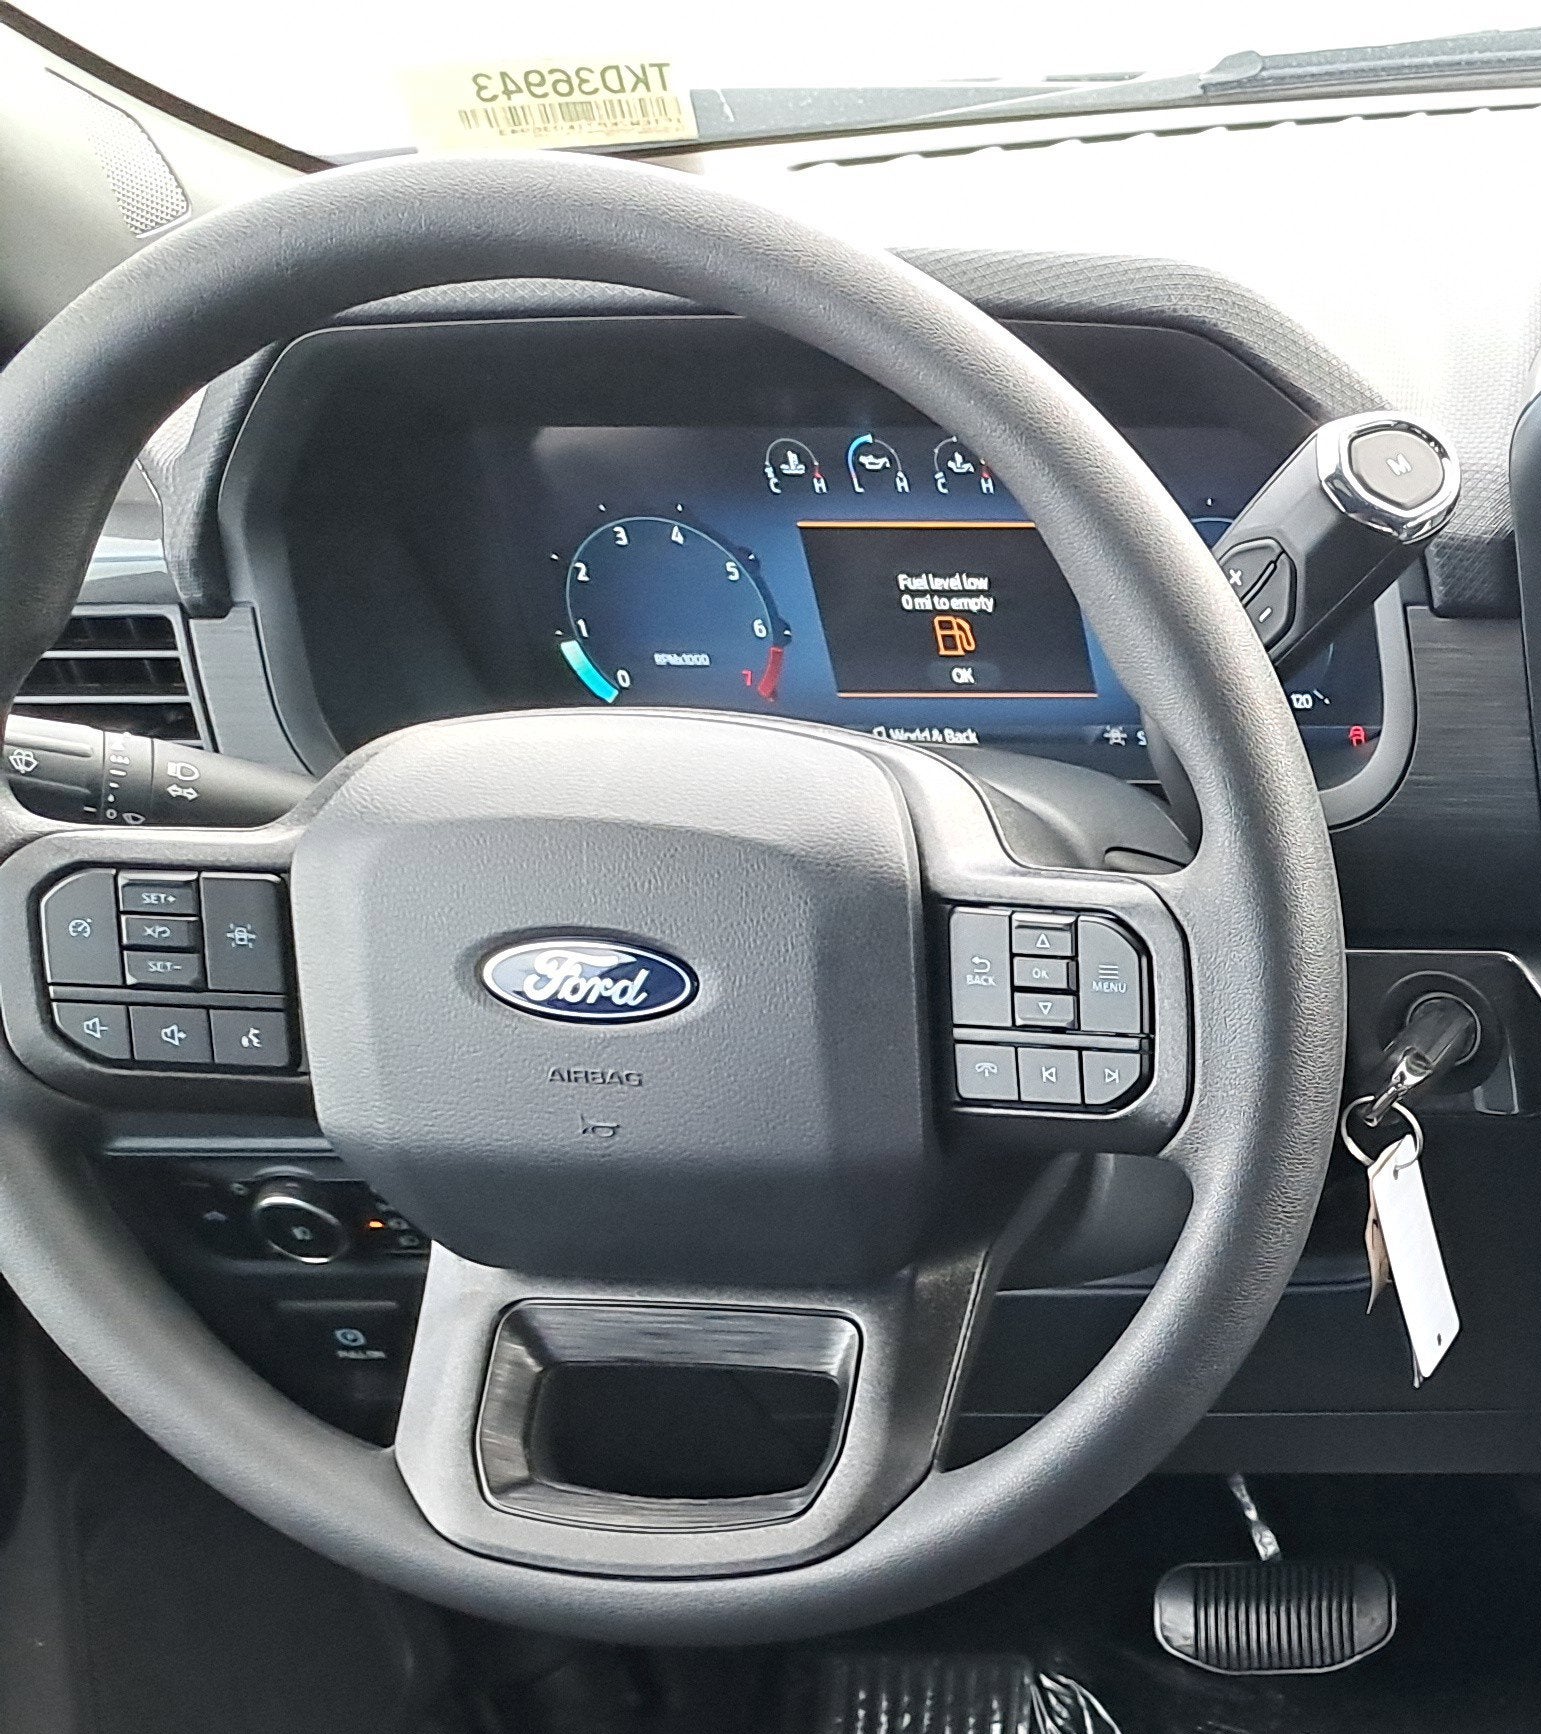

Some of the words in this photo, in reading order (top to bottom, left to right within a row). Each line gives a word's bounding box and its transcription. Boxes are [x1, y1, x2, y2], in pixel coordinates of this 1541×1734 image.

[612, 526, 629, 546] 3
[671, 525, 684, 545] 4
[574, 562, 590, 581] 2
[725, 561, 740, 581] 5
[897, 573, 930, 590] Fuel
[928, 573, 962, 590] level
[962, 573, 989, 590] low
[901, 594, 913, 610] 0
[933, 595, 950, 610] to
[950, 595, 994, 612] empty
[576, 618, 588, 638] 1
[753, 619, 767, 638] 6
[616, 669, 631, 688] 0
[951, 667, 975, 684] OK
[523, 950, 648, 1007] Ford
[966, 974, 997, 987] BACK
[1032, 968, 1050, 980] OK
[1091, 980, 1128, 994] MENU
[548, 1067, 644, 1087] AIRBAG
